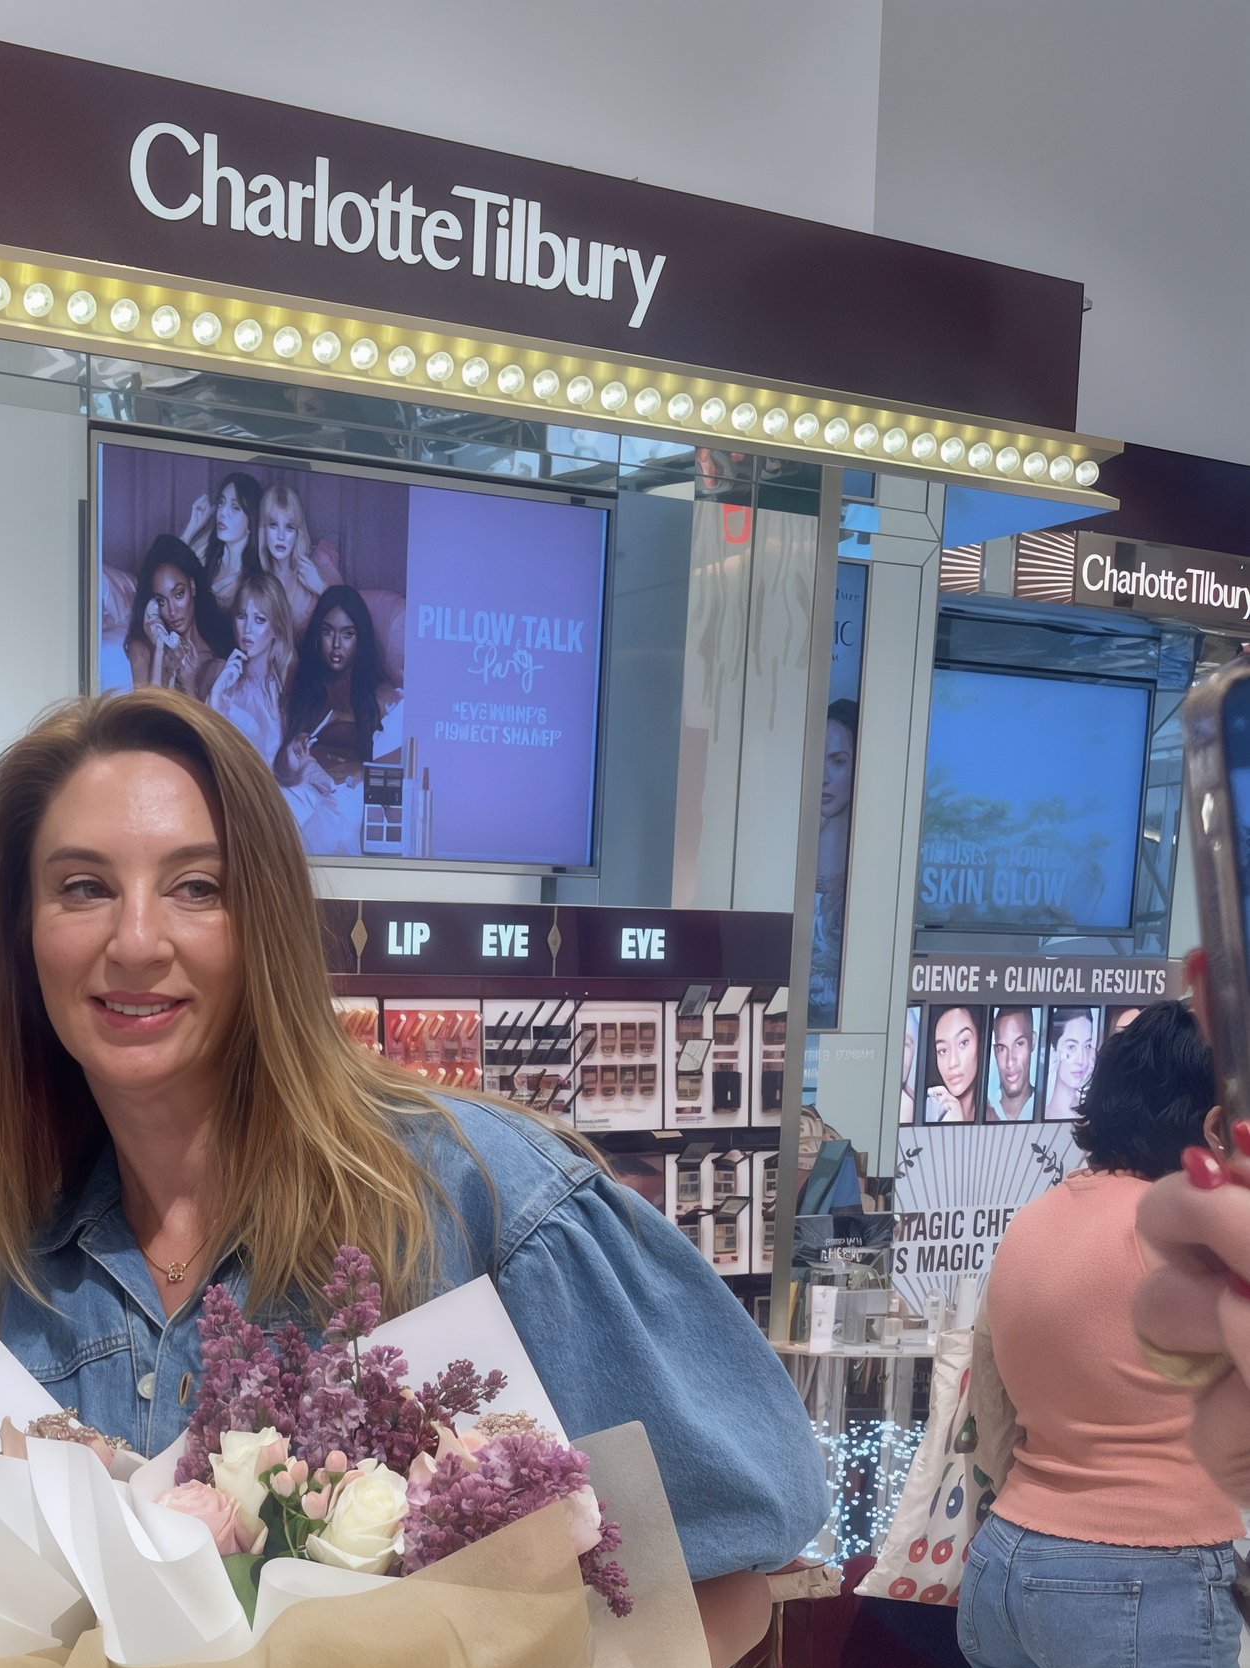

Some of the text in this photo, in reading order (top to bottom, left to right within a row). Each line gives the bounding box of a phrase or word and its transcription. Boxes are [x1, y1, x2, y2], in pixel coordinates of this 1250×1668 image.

[417, 604, 585, 653] PILLOW TALK
[920, 866, 1067, 908] SKIN GLOW
[388, 921, 431, 955] LIP
[481, 924, 530, 957] EYE
[621, 927, 666, 960] EYE
[1004, 966, 1086, 993] CLINICAL
[1091, 968, 1166, 995] RESULTS
[916, 1242, 985, 1273] MAGIC
